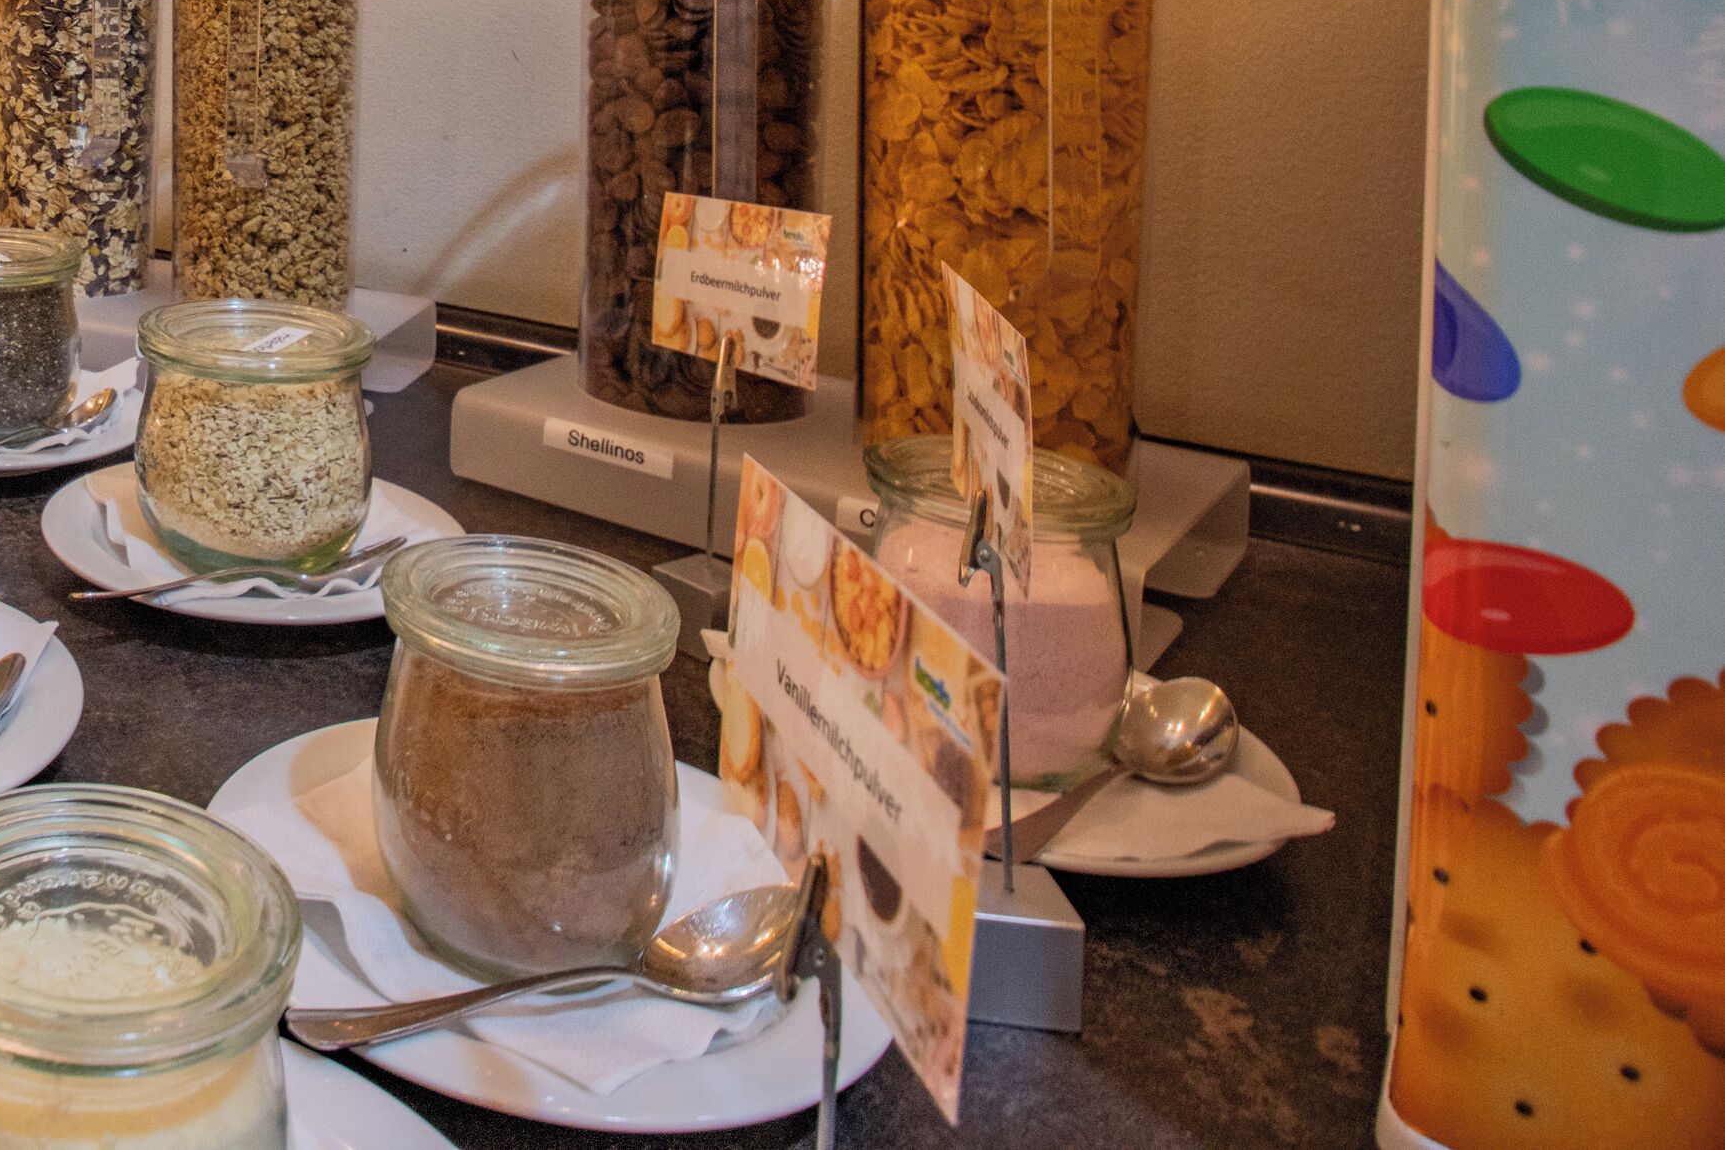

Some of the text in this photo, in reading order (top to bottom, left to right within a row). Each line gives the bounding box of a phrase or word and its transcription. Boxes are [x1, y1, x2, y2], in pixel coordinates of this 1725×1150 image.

[690, 270, 781, 301] Erdbeermilchpulver
[568, 429, 645, 464] Shellinos
[777, 658, 902, 824] Vanillemilchpulver
